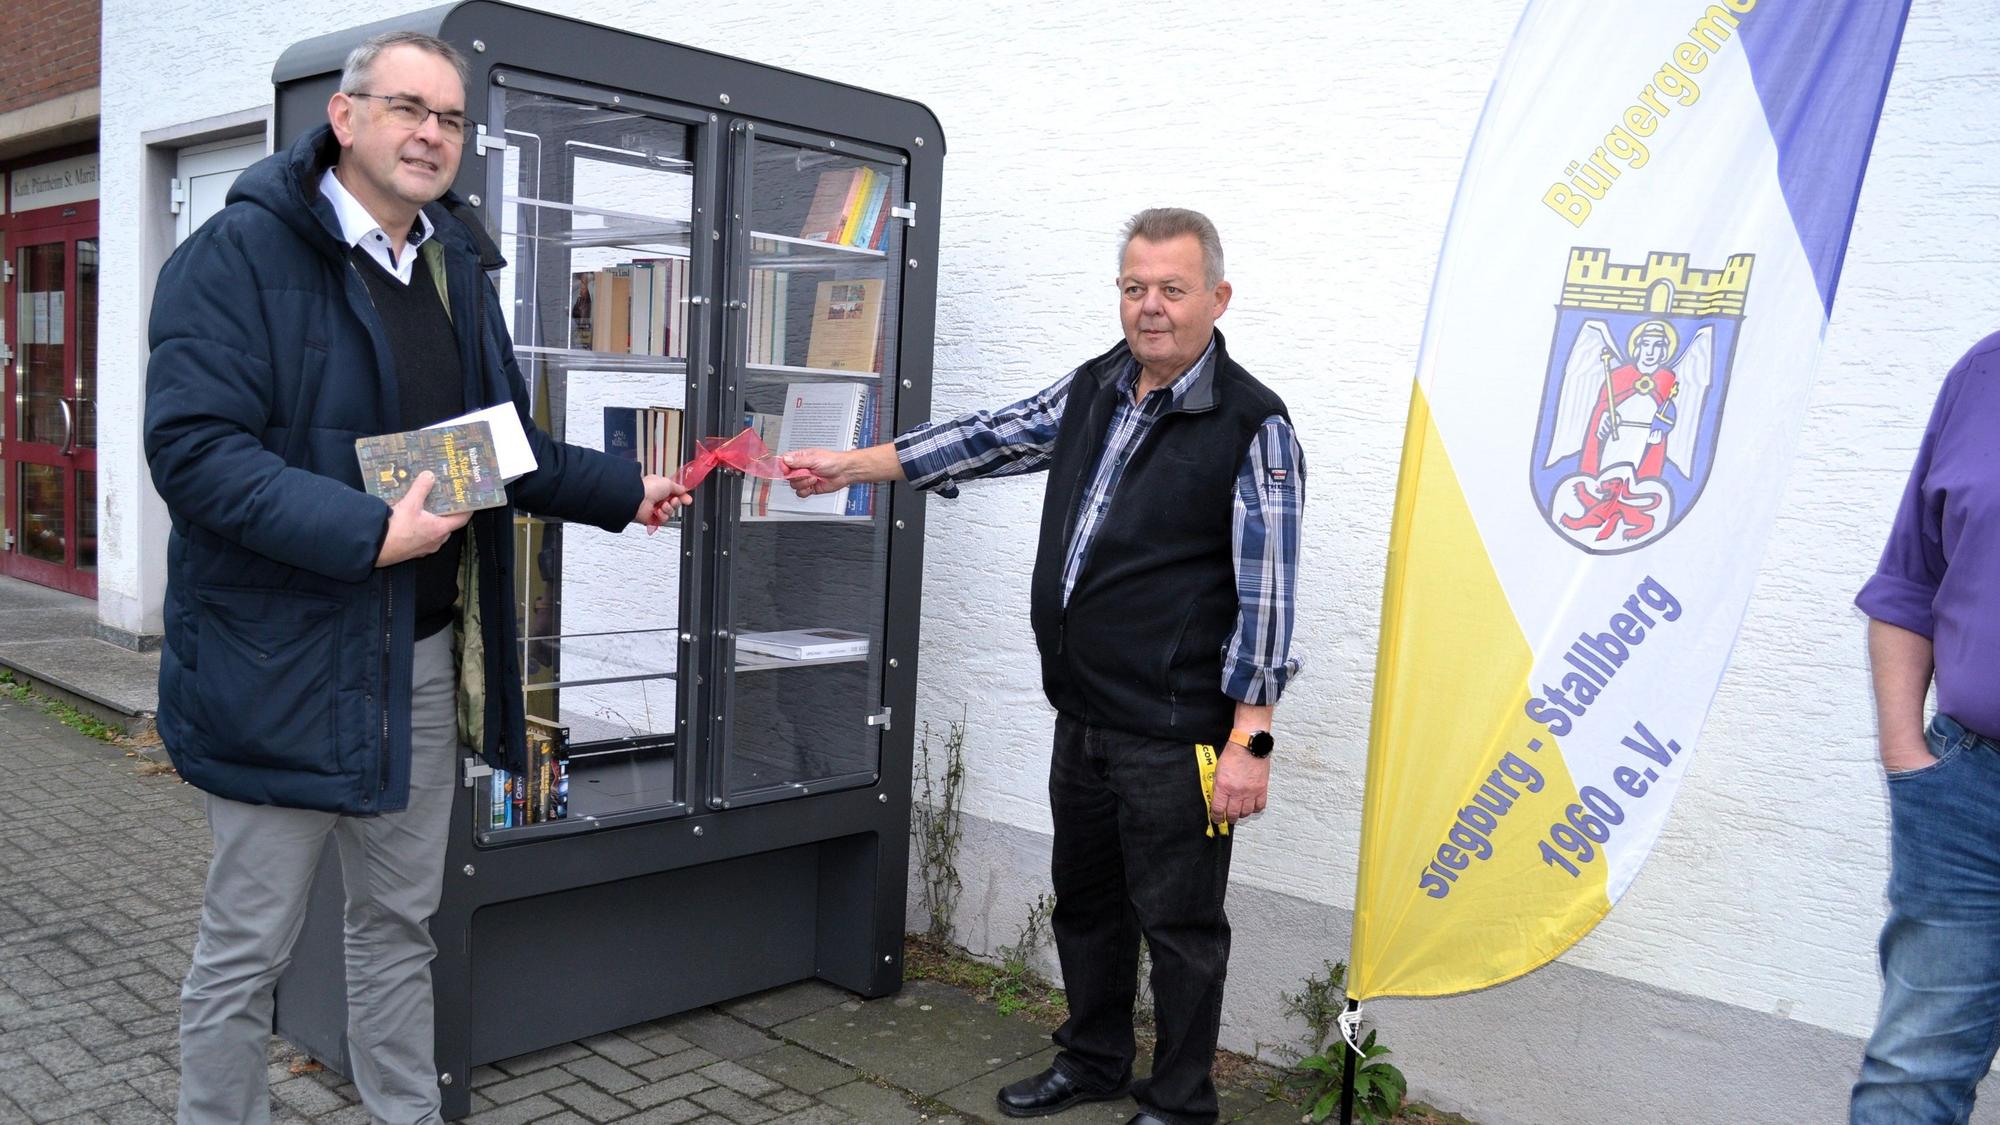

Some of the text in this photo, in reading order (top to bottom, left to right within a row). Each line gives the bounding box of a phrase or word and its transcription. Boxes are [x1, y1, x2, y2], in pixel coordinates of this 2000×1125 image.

[1418, 751, 1545, 899] Siegburg
[1525, 575, 1682, 737] Stallberg
[1538, 720, 1682, 879] 1960 e.V.
